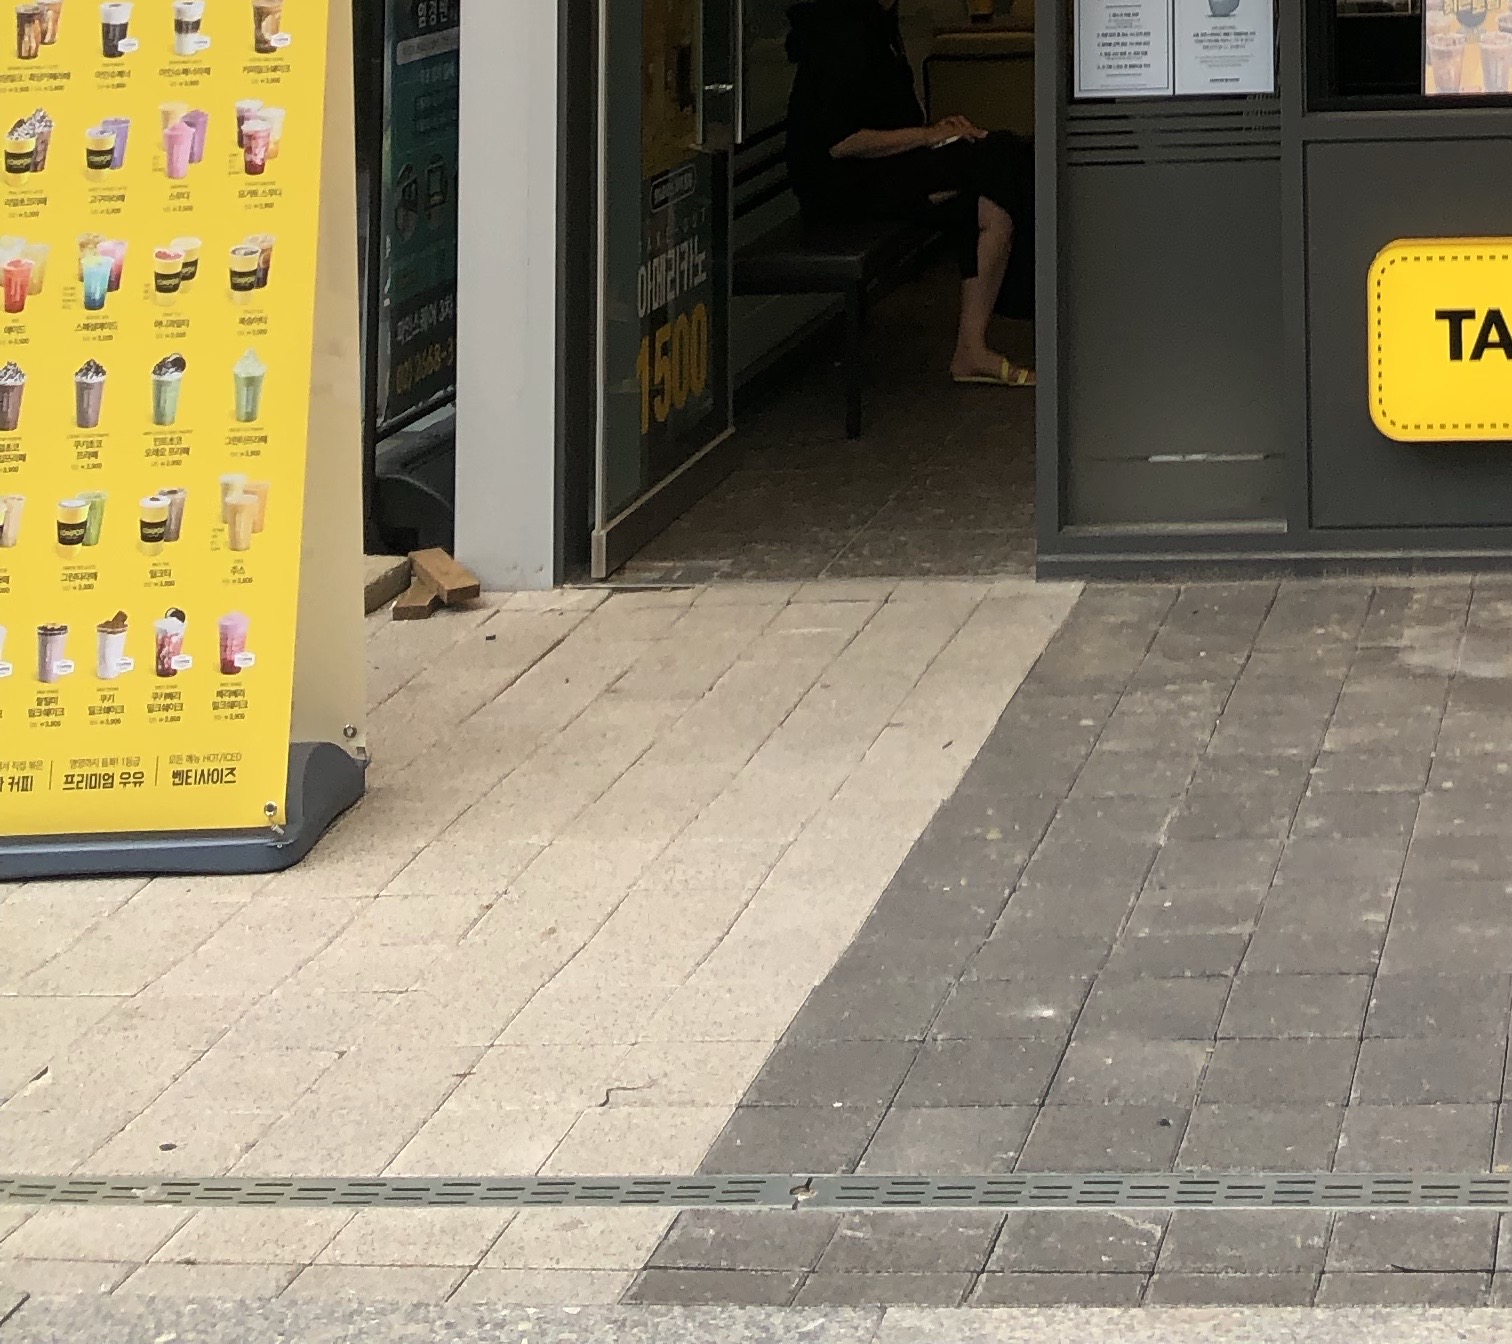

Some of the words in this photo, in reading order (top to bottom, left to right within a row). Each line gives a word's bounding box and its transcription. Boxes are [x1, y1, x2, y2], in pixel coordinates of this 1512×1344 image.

[636, 303, 708, 436] 1500
[62, 771, 115, 791] 프리미엄
[118, 770, 145, 788] 우유
